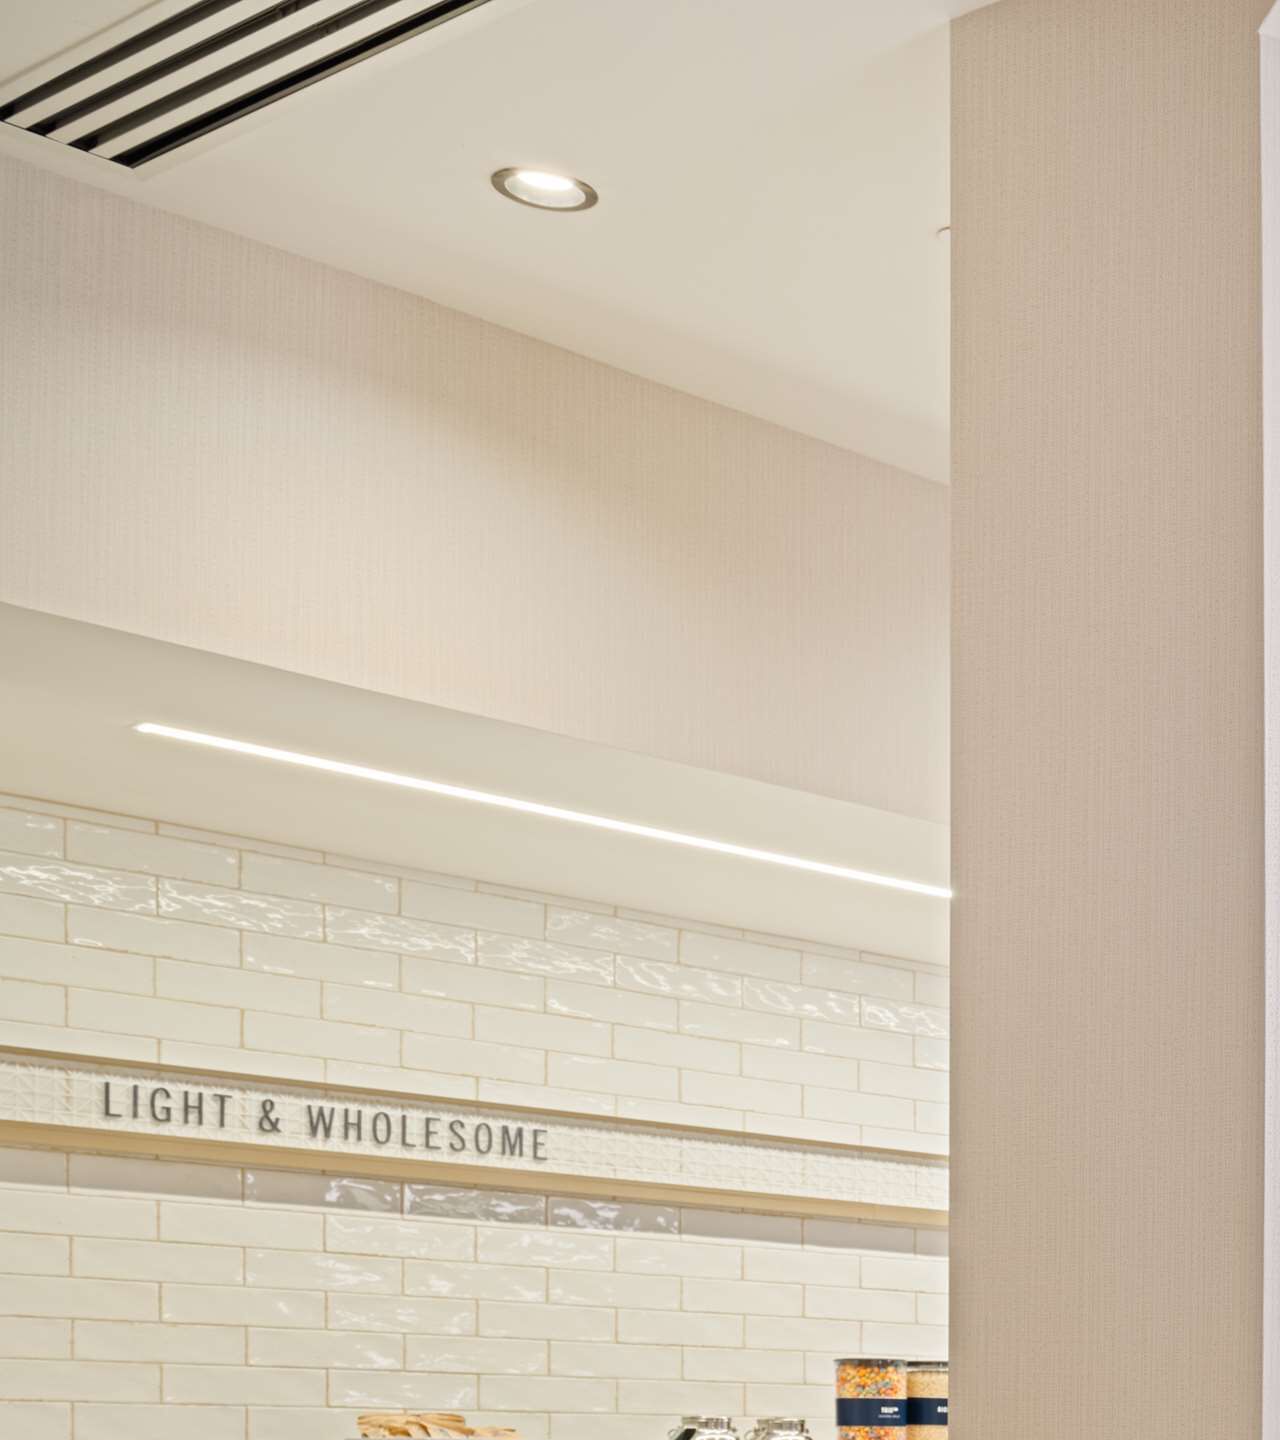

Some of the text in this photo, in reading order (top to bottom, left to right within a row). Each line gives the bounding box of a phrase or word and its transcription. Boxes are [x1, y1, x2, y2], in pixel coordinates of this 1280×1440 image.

[102, 1081, 549, 1162] LIGHT & WHOLESOME
